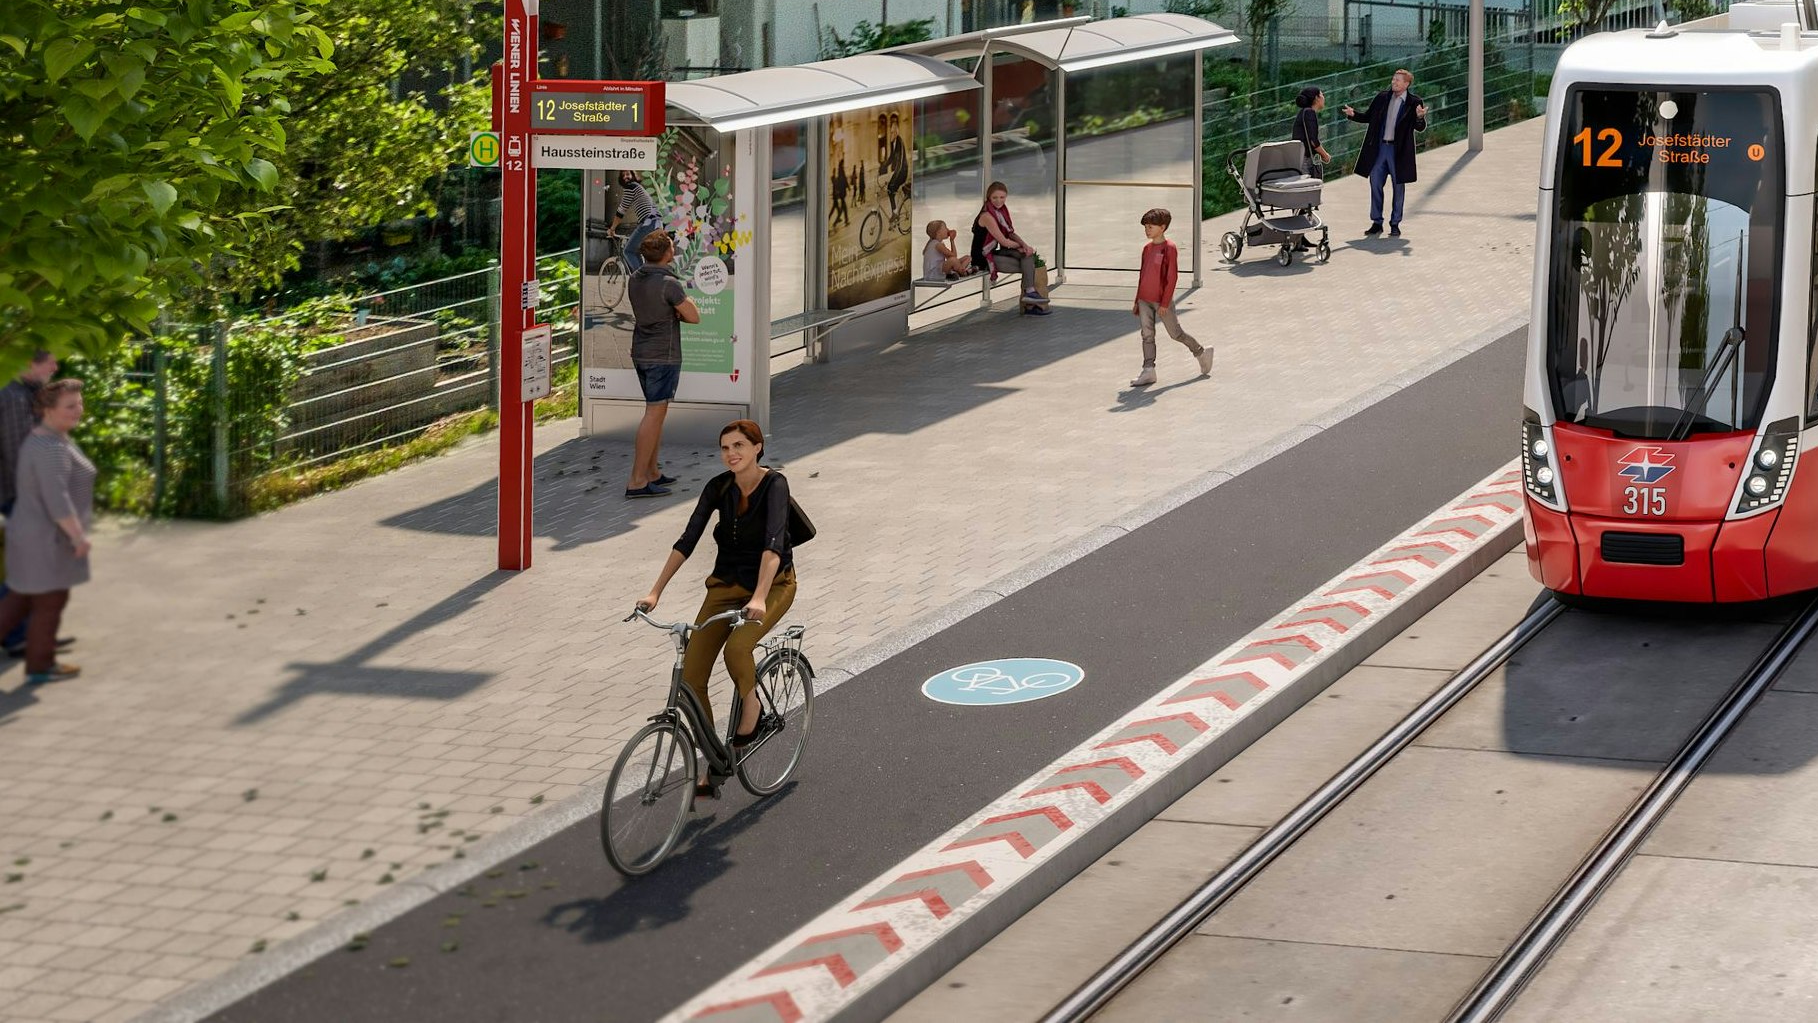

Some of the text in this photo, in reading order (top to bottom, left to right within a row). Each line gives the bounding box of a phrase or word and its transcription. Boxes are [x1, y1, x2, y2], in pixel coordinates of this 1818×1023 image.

[510, 18, 520, 114] WIENER LINIEN
[537, 99, 556, 120] 12
[558, 99, 627, 112] Josefstädter
[631, 102, 639, 123] 1
[573, 110, 611, 123] Straße
[1573, 126, 1623, 168] 12
[1637, 132, 1732, 148] Josefstädter
[479, 141, 493, 158] H
[541, 145, 646, 160] Haussteinstraße
[1658, 149, 1710, 164] Straße
[506, 160, 523, 171] 12
[831, 245, 859, 267] Mein
[589, 375, 606, 383] Stadt
[1623, 486, 1667, 516] 315
